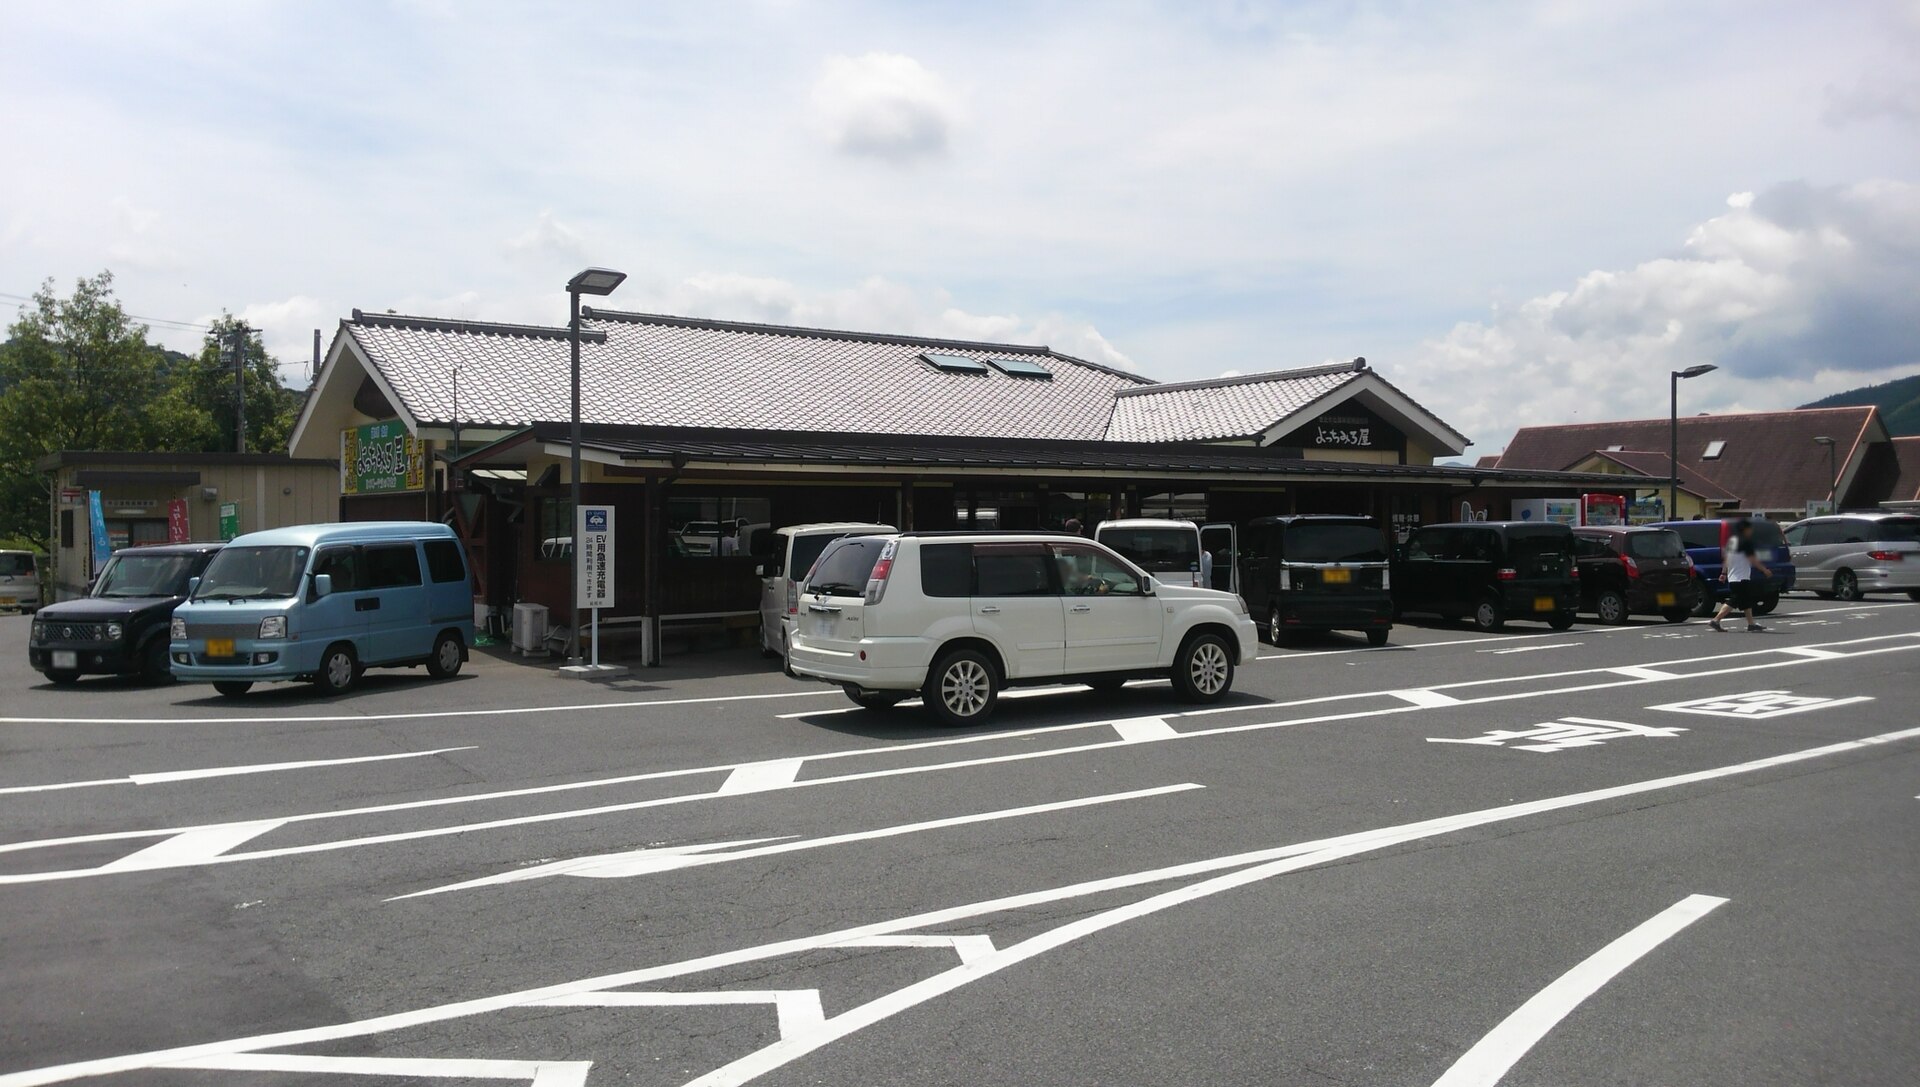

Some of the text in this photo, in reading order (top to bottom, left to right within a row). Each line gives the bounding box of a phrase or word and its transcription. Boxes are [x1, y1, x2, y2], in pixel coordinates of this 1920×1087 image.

[357, 434, 406, 477] よっちみろ屋
[1315, 426, 1372, 446] よっちみろ屋
[596, 535, 607, 599] EV用急速充電器
